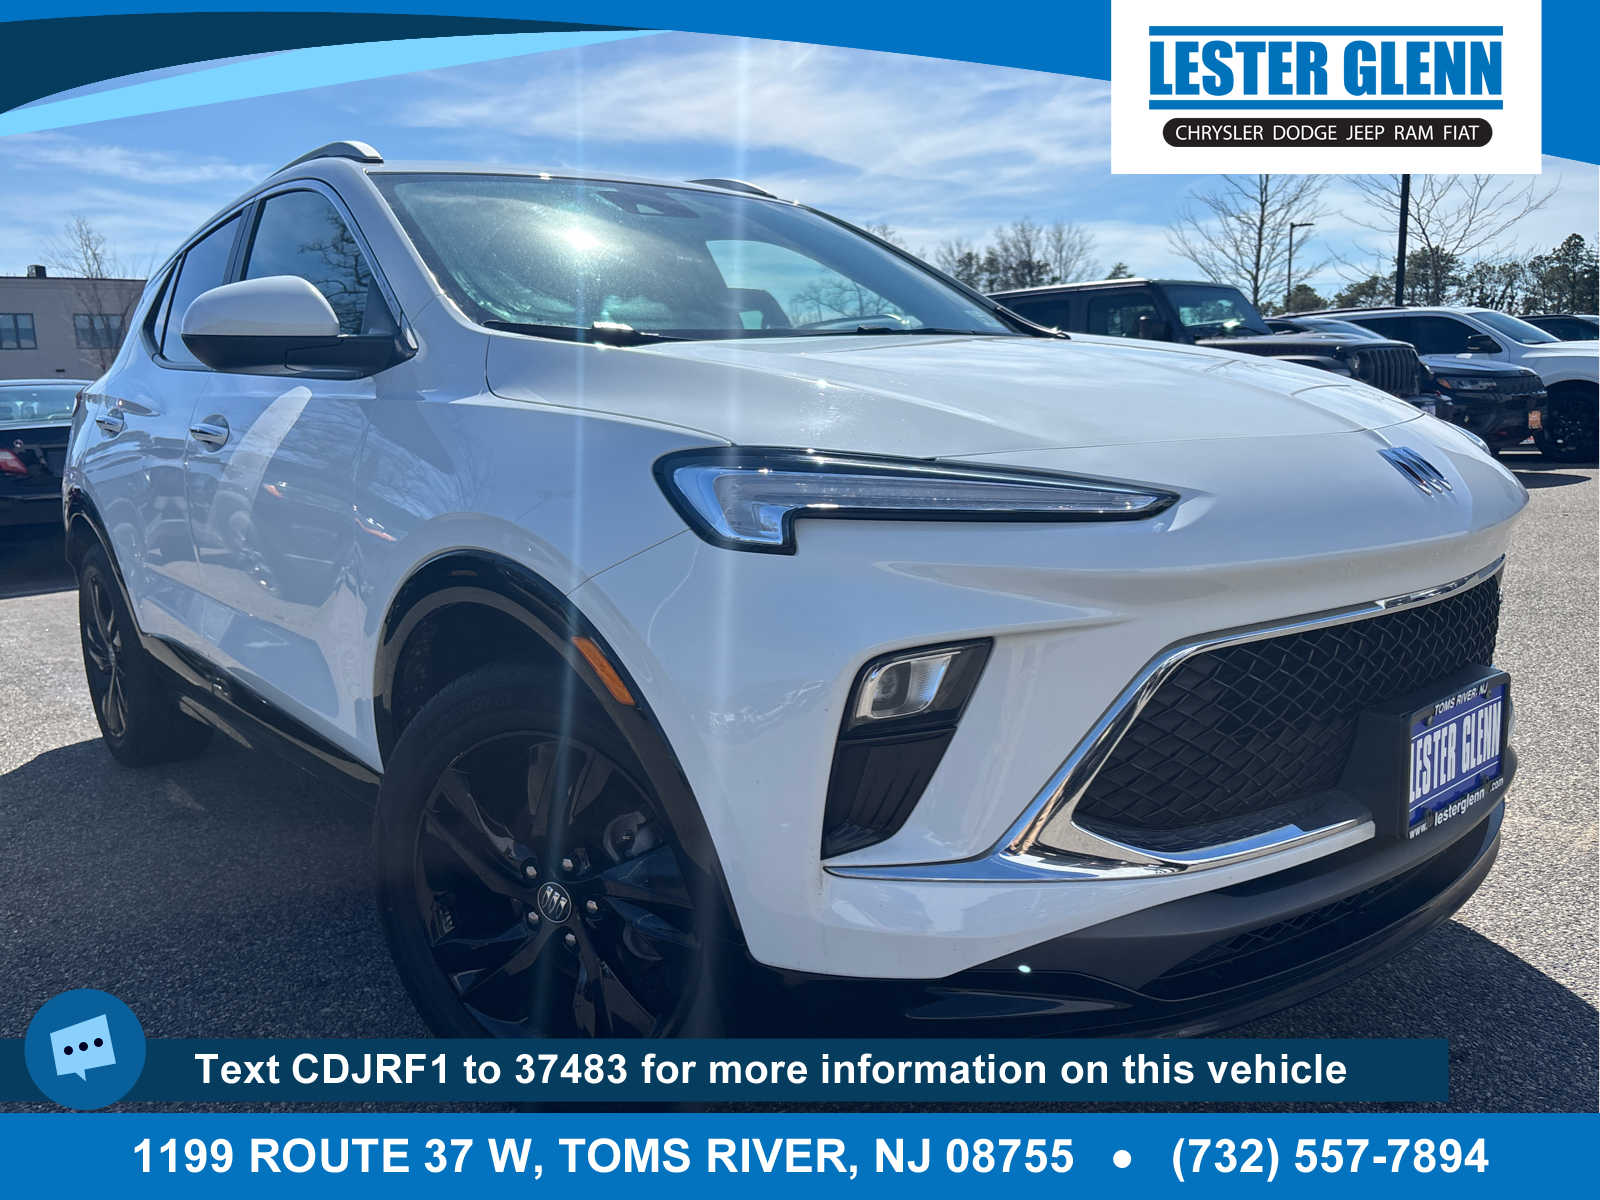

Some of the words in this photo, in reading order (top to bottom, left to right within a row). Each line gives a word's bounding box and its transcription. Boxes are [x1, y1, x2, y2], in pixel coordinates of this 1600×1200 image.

[1434, 697, 1456, 716] TOMS
[1478, 682, 1489, 696] NJ
[1409, 723, 1457, 804] LESTER
[1461, 701, 1502, 774] GLENN
